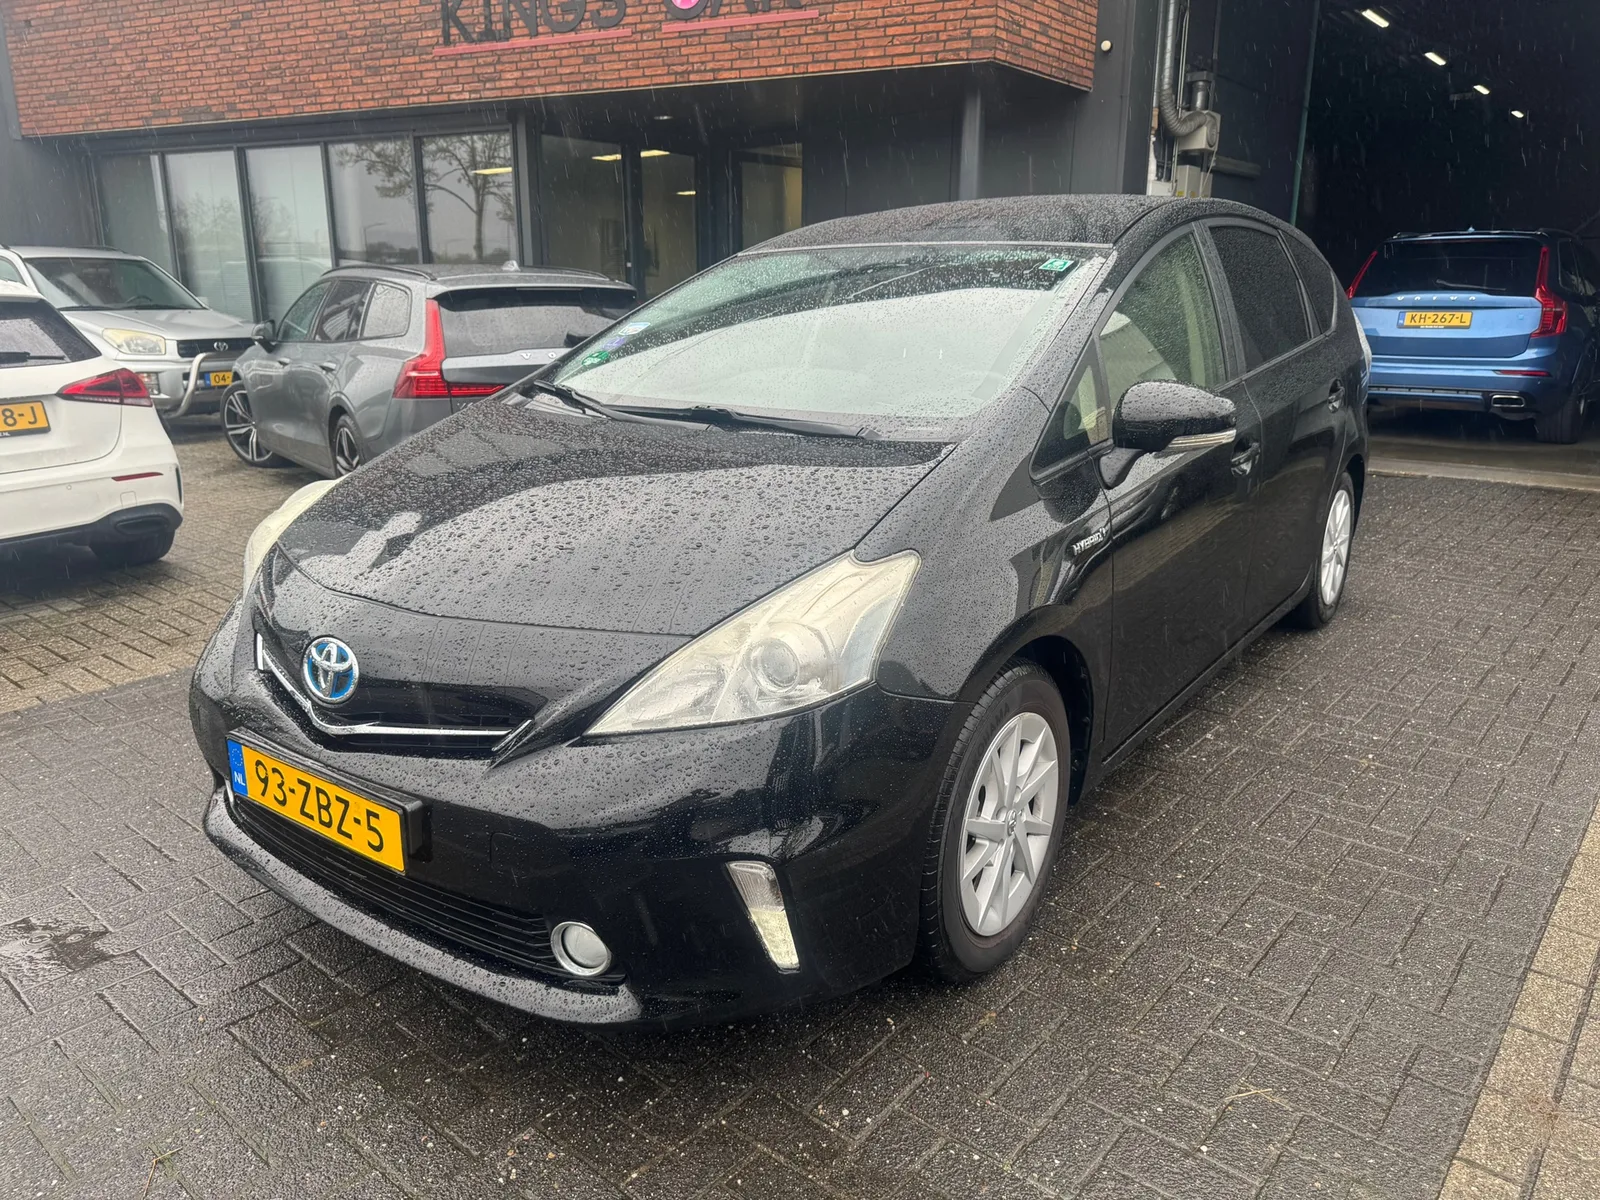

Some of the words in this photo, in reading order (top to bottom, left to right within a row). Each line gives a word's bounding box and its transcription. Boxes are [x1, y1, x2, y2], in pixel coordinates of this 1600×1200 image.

[1409, 313, 1467, 324] KH-267-L
[233, 770, 247, 787] NL
[254, 759, 385, 853] 93-ZBZ-5
